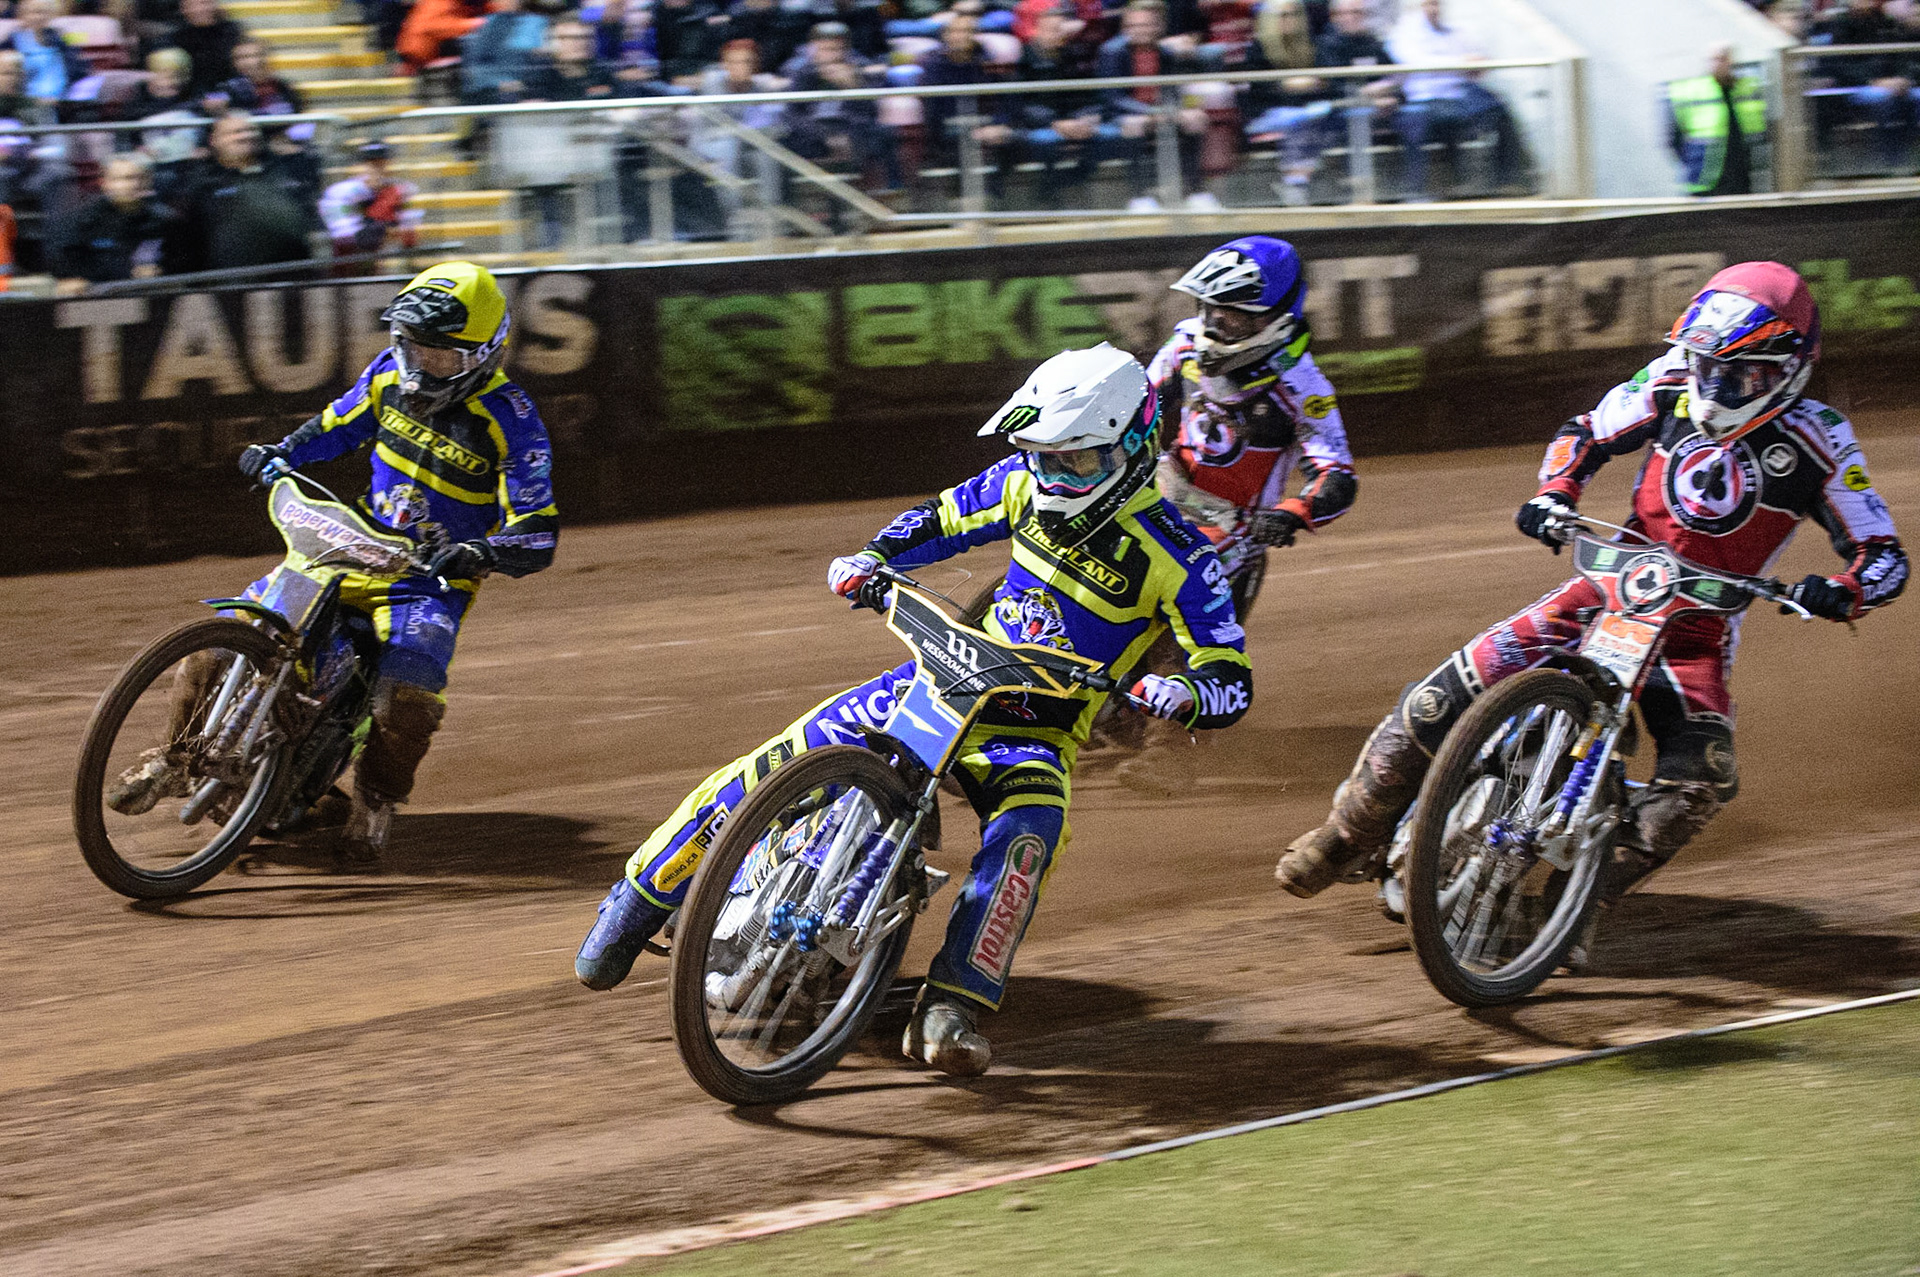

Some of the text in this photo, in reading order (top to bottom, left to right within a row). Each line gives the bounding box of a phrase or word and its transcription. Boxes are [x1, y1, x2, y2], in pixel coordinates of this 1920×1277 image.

[381, 411, 484, 471] TRU PLANT
[282, 502, 327, 530] Roger
[975, 873, 1031, 972] Castrol
